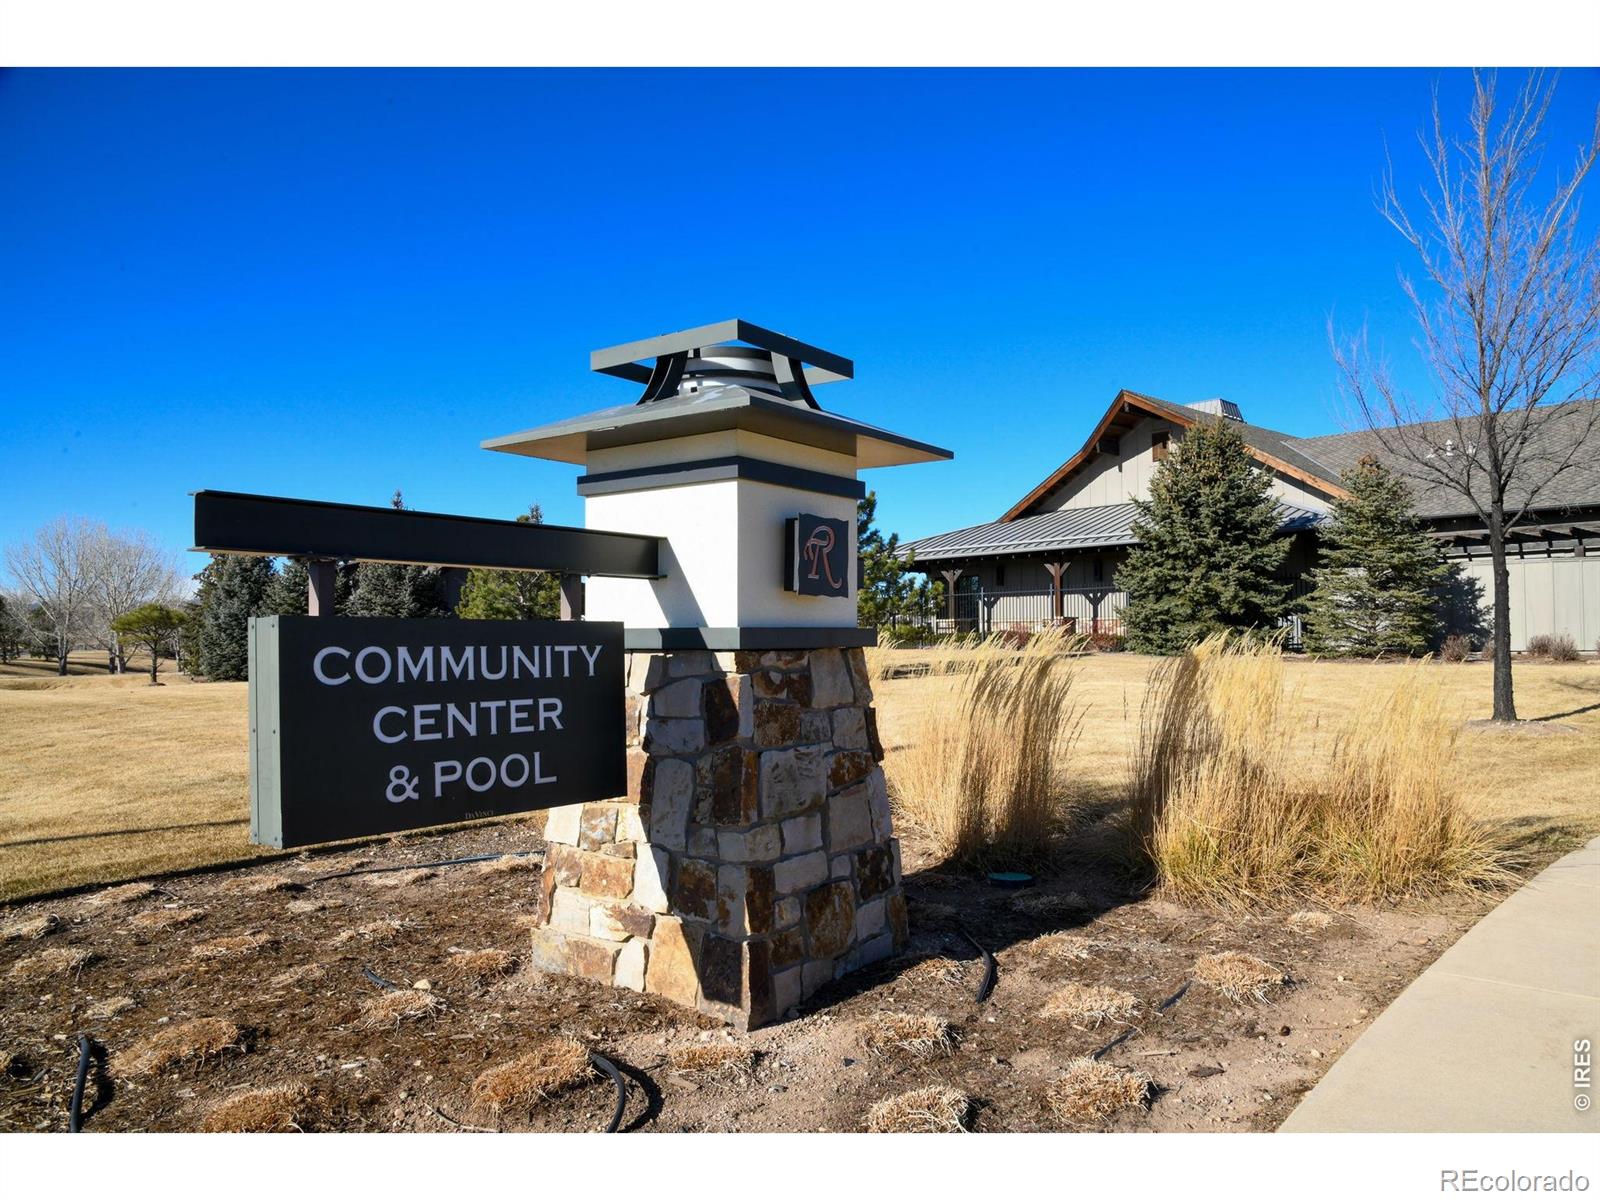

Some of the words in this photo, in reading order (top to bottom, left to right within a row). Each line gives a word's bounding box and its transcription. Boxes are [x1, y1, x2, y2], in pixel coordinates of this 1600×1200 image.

[804, 525, 842, 588] R
[313, 645, 602, 685] COMMUNITY
[373, 698, 563, 743] CENTER
[385, 765, 419, 802] &
[434, 751, 557, 797] POOL
